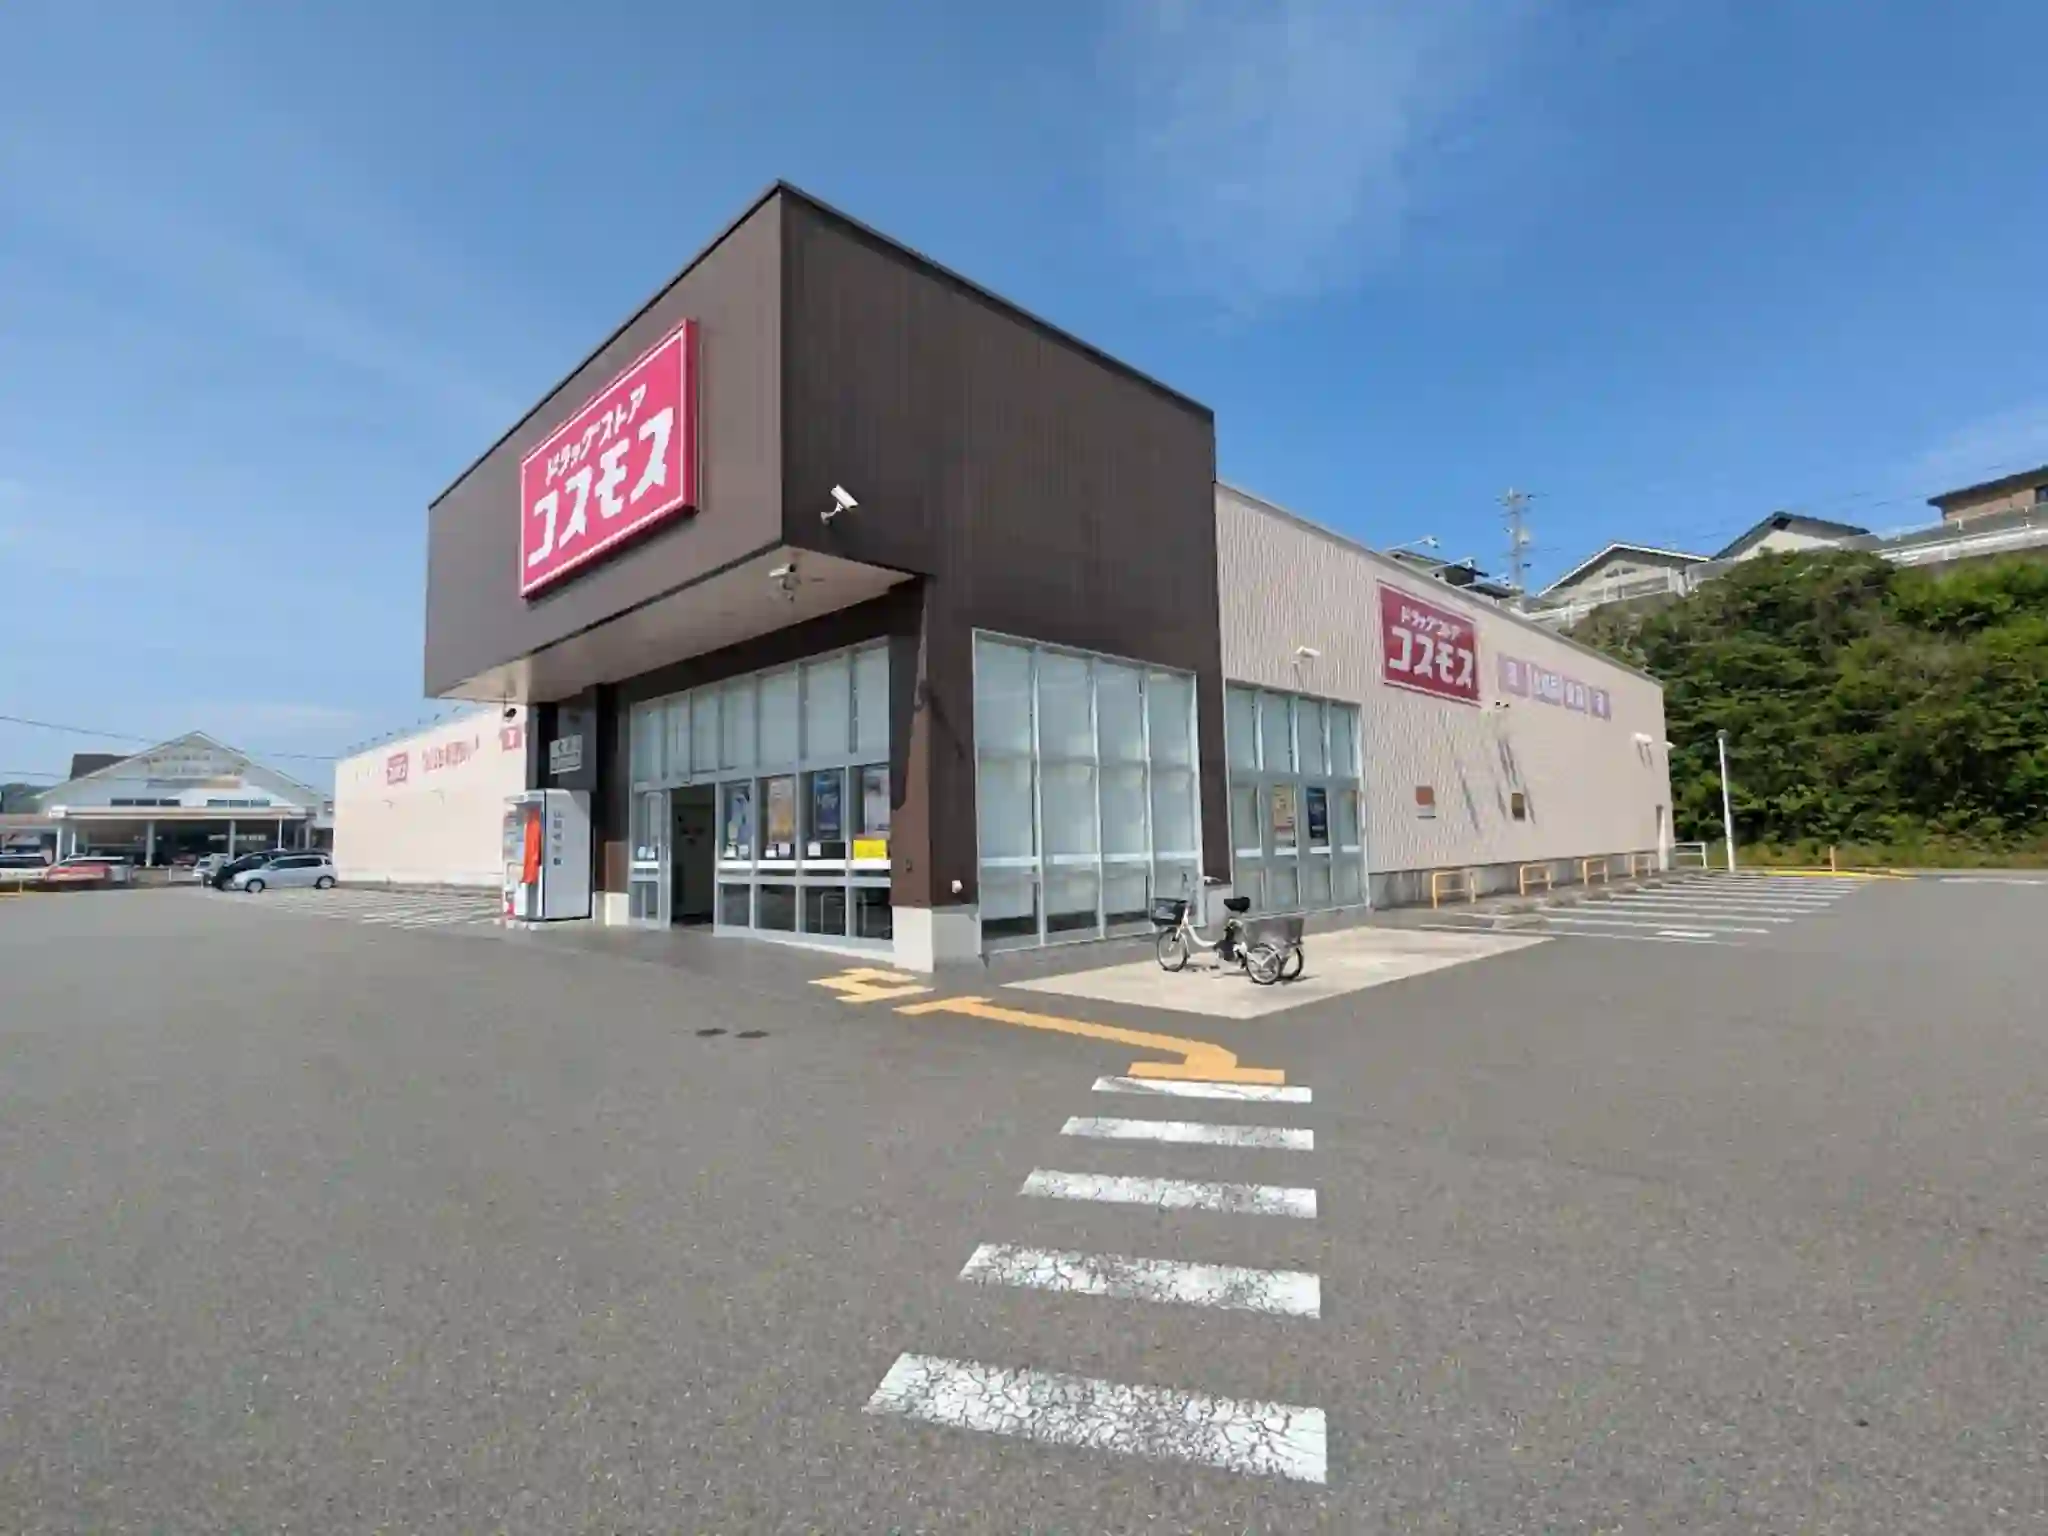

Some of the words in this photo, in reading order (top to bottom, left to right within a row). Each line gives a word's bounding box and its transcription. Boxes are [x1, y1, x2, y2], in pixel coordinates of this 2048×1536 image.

[546, 383, 646, 486] ドラッグストア
[528, 407, 674, 567] コスモス
[1389, 625, 1474, 690] コスモス
